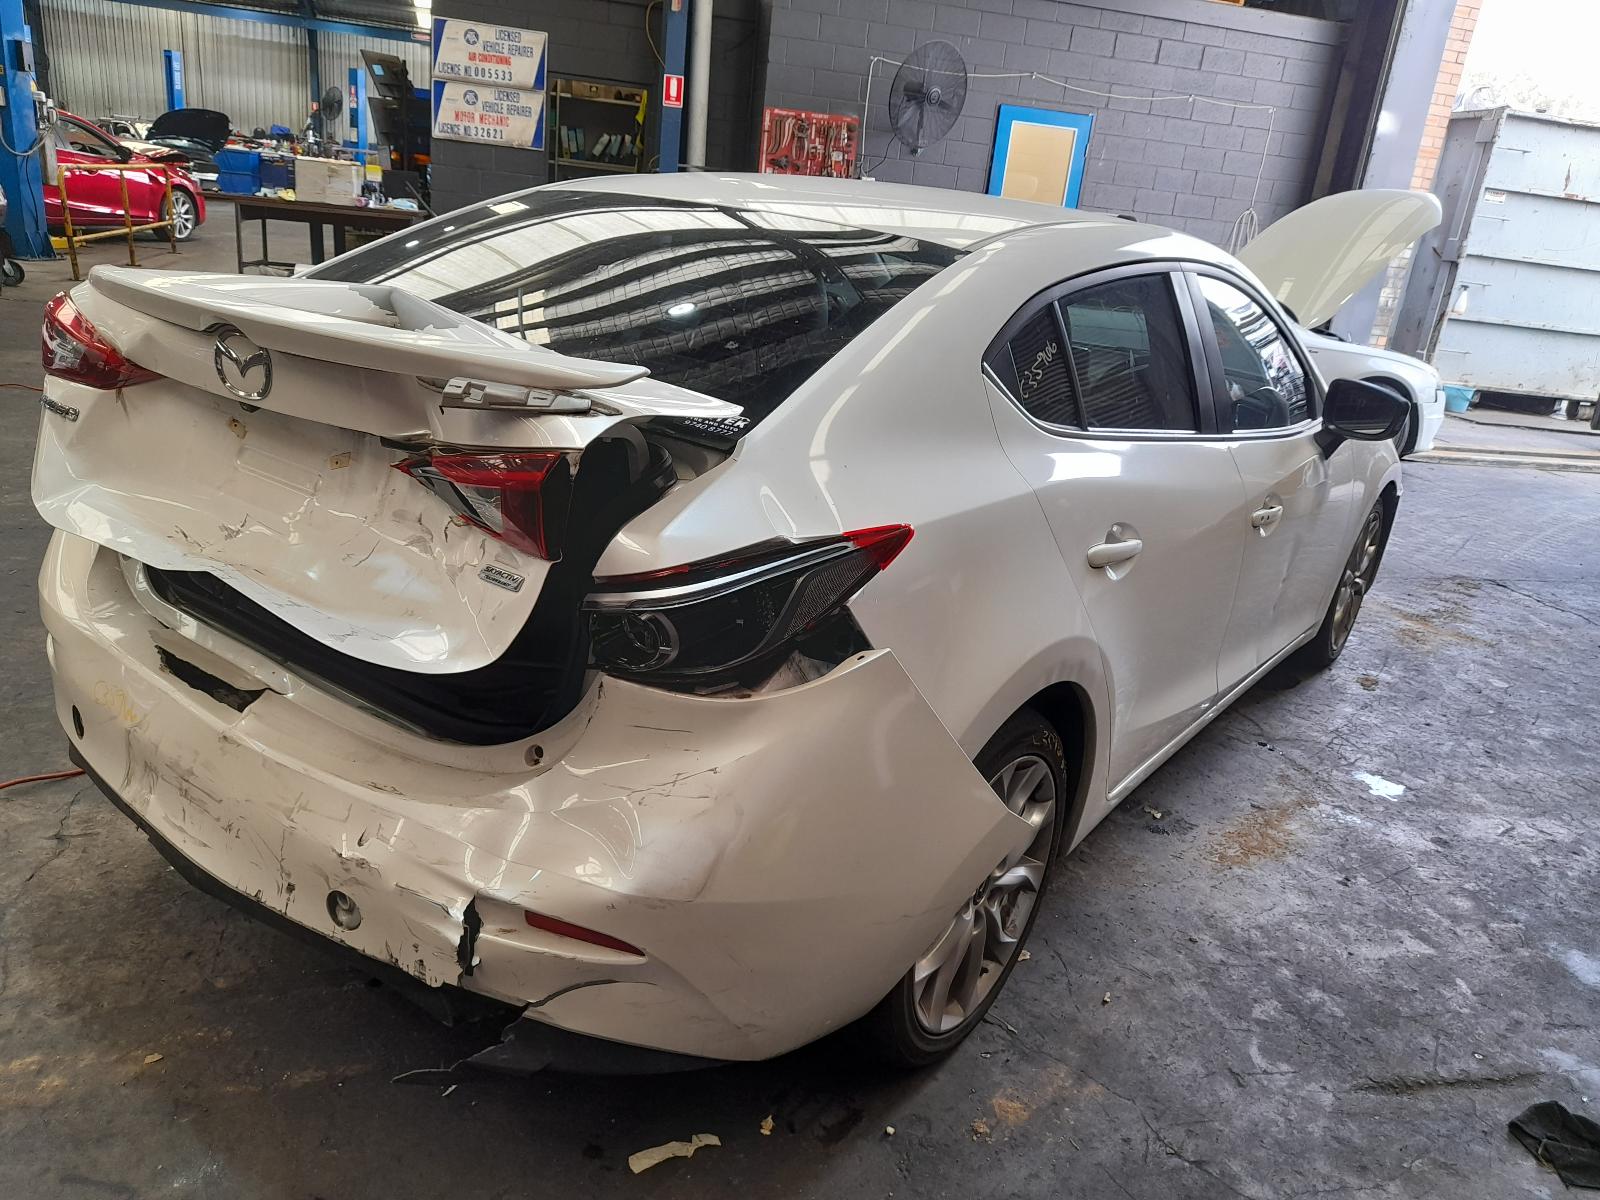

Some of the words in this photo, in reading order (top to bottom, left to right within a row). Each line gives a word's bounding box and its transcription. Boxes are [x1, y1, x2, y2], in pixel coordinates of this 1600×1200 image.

[495, 29, 521, 43] LICENSED
[482, 40, 504, 54] VEHICLE
[508, 44, 534, 58] REPAIRER
[468, 51, 476, 62] AIR
[478, 52, 512, 66] CONDITIONING
[438, 62, 461, 75] LICENCE
[474, 67, 512, 81] 005533
[494, 90, 520, 103] LICENSED
[482, 101, 504, 114] VEHICLE
[506, 104, 532, 118] REPAIRER
[454, 110, 475, 123] MOTOR
[479, 114, 510, 127] MECHANIC
[438, 122, 461, 135] LICENCE
[474, 126, 504, 140] 32621
